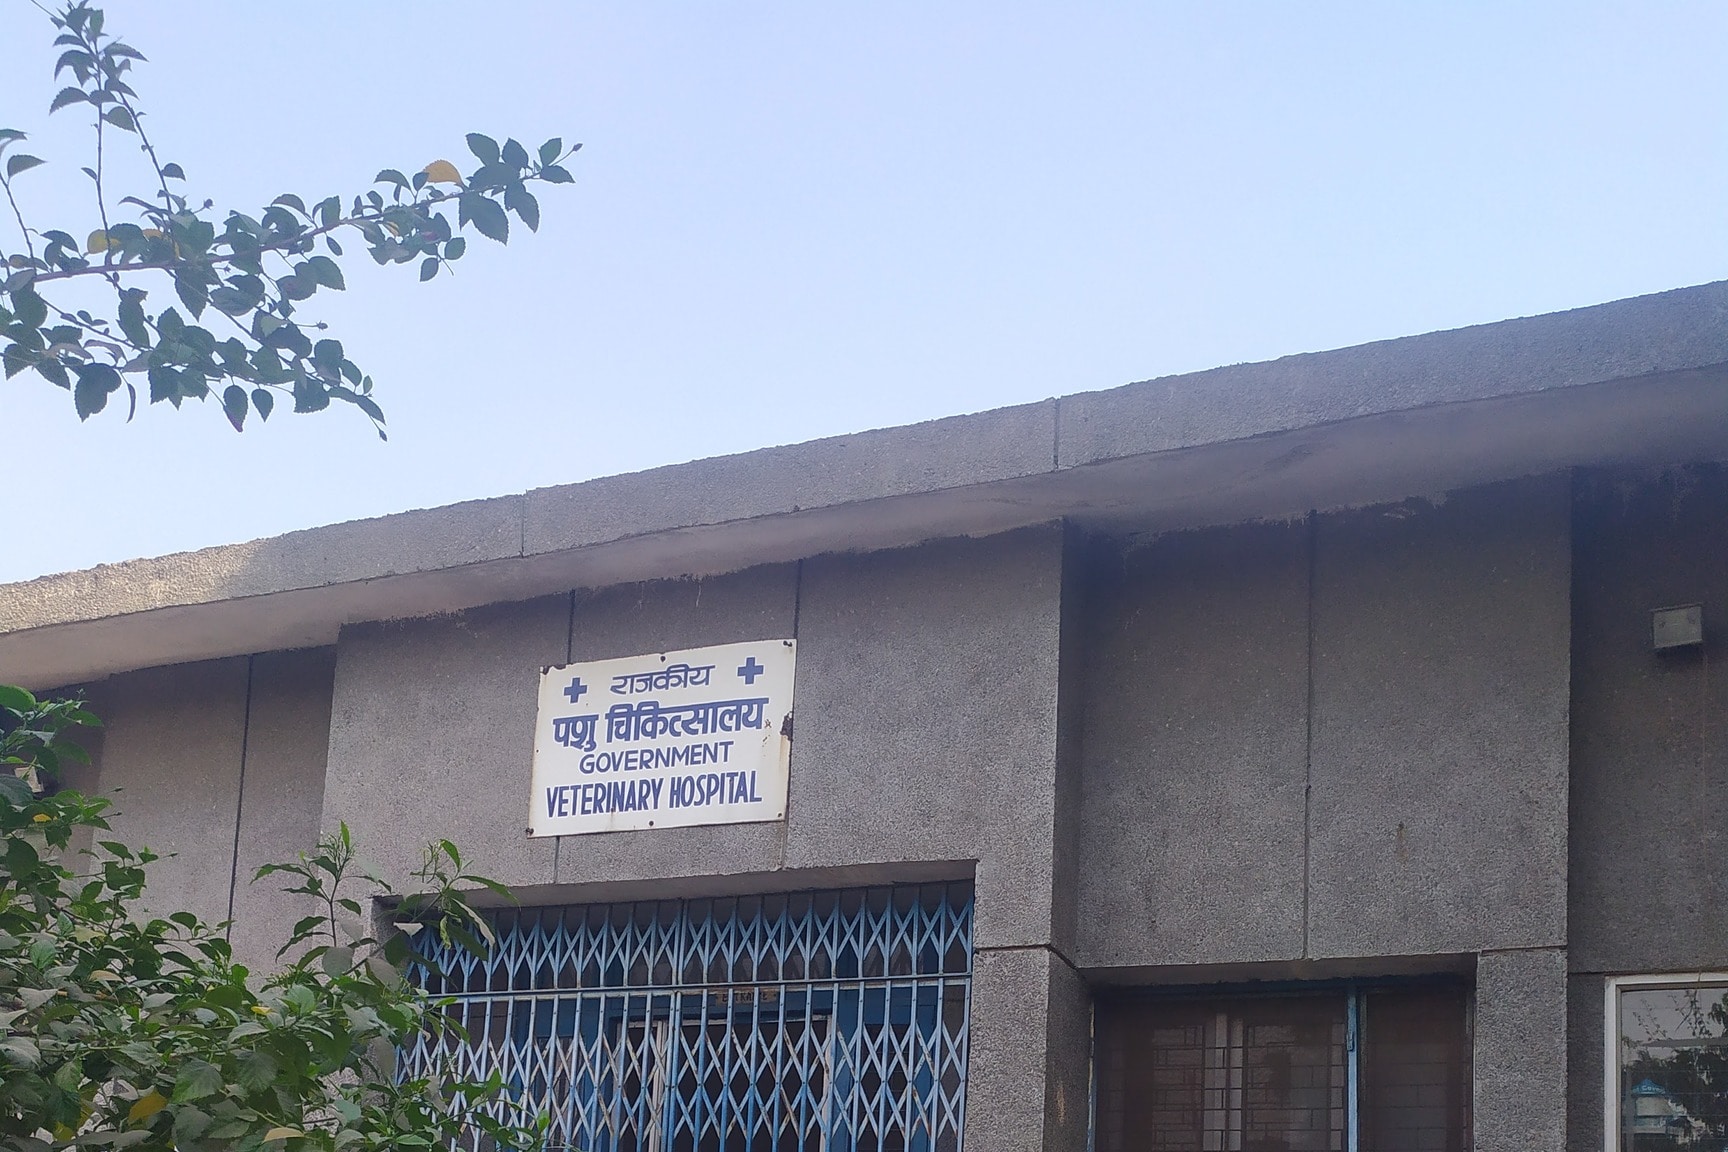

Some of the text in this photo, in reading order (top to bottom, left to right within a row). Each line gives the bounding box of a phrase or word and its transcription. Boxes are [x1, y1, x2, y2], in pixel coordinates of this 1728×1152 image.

[610, 664, 715, 695] राजकीय
[553, 698, 769, 751] पशु चिकित्सालय
[579, 741, 734, 774] GOVERNMENT
[546, 770, 762, 818] VETERINARY HOSPITAL
